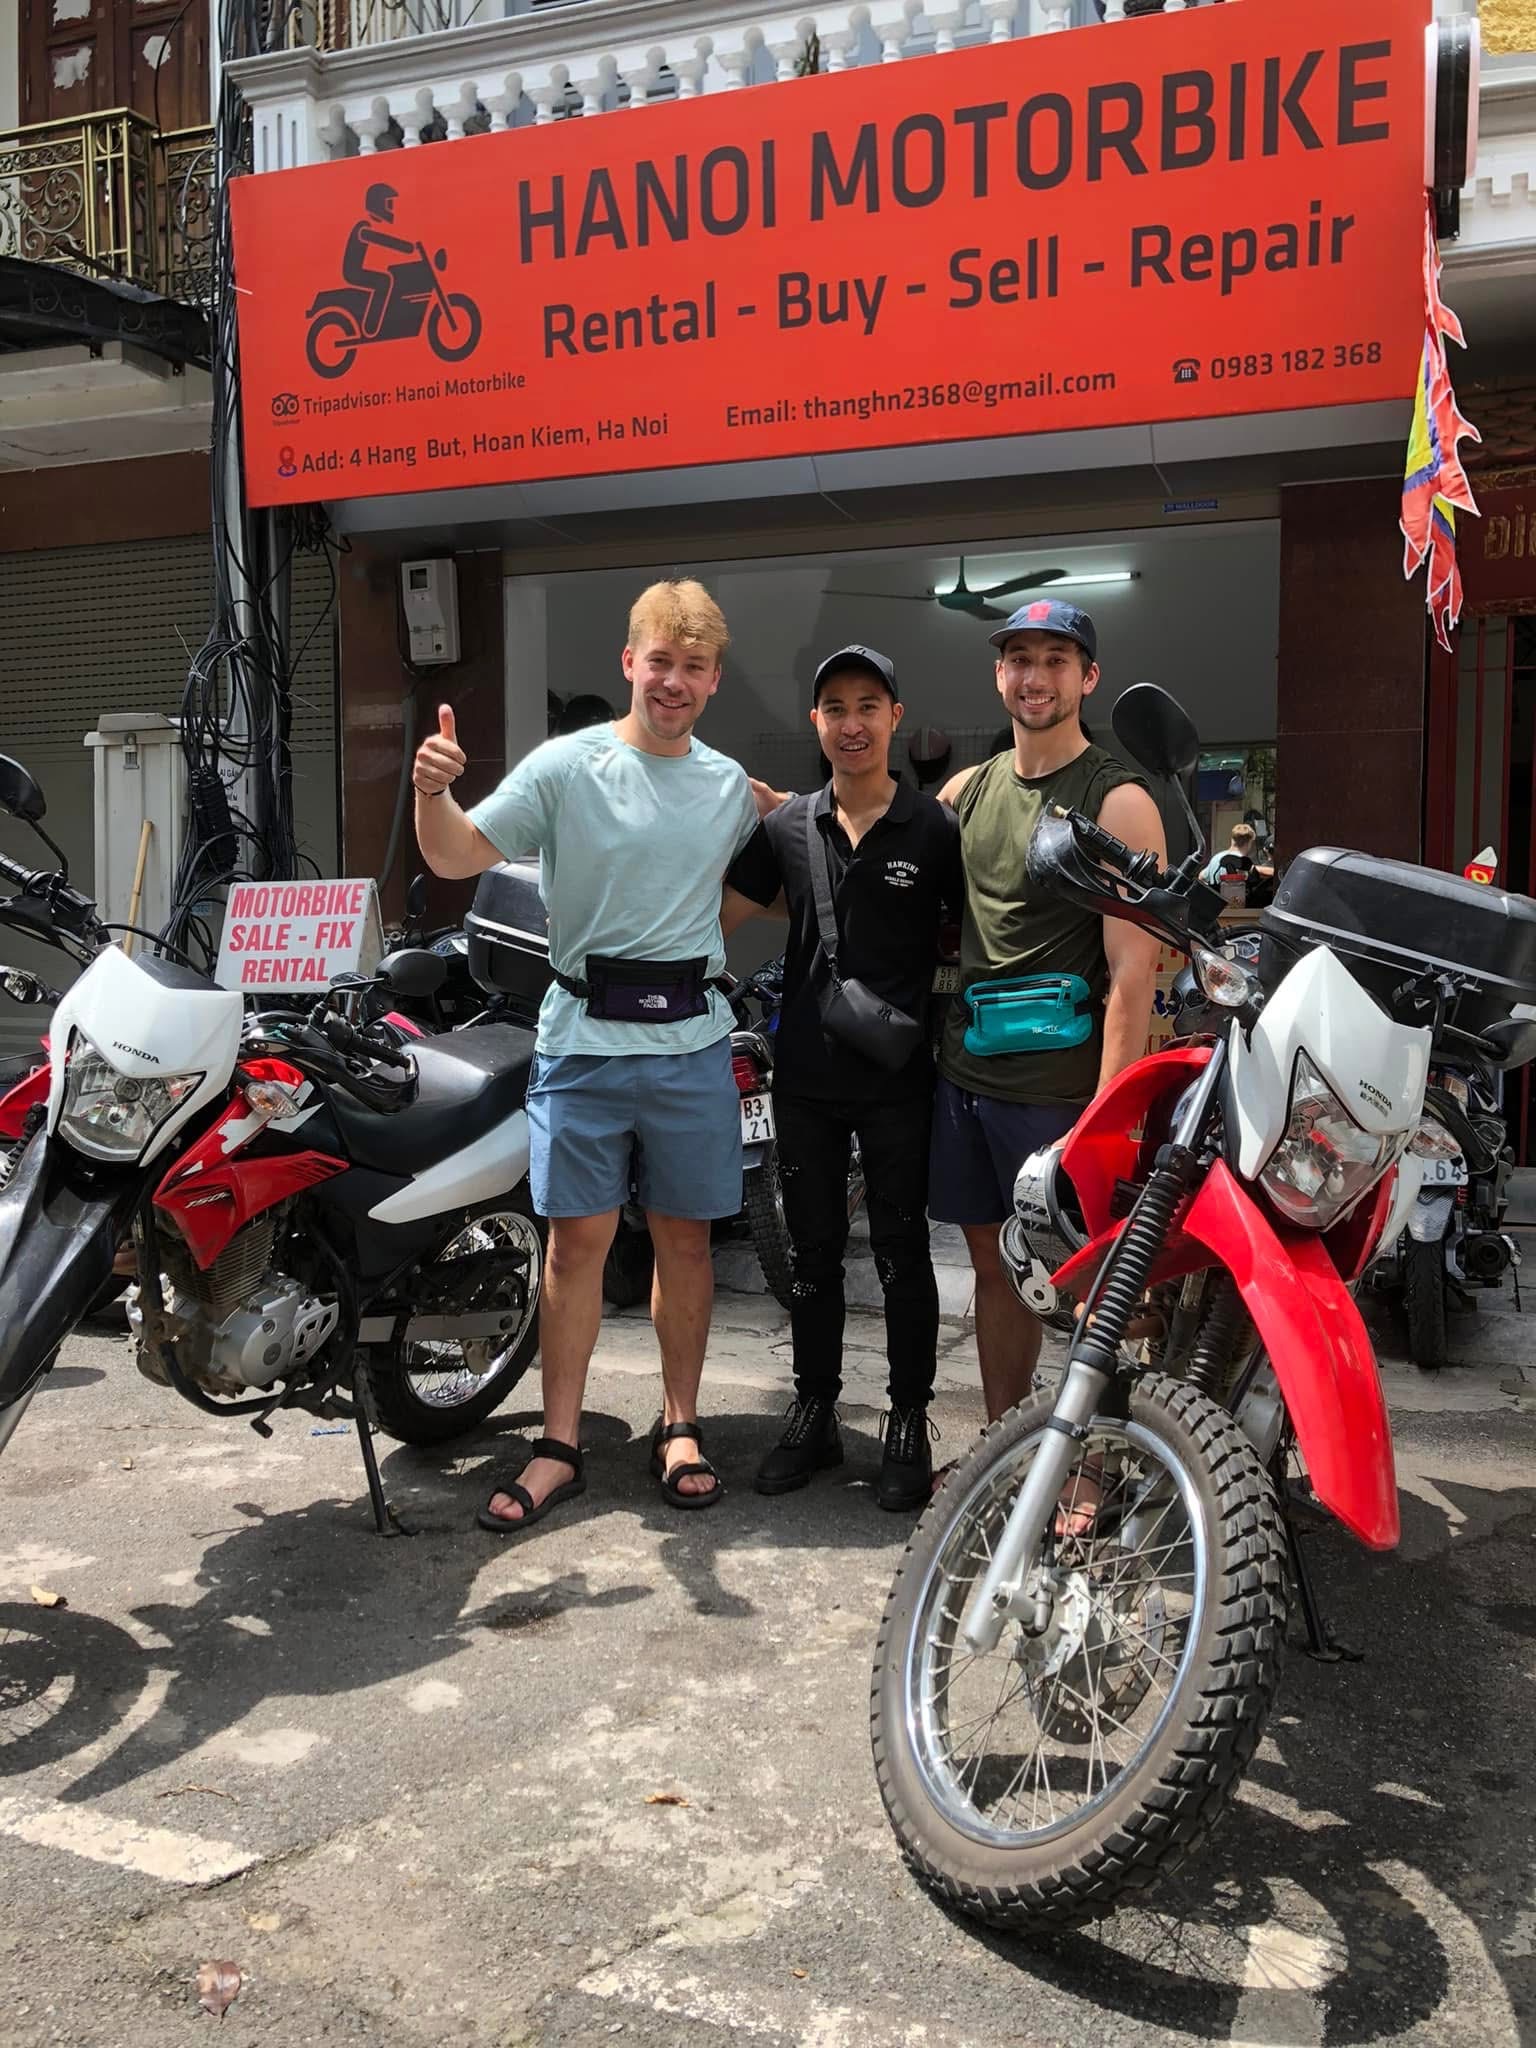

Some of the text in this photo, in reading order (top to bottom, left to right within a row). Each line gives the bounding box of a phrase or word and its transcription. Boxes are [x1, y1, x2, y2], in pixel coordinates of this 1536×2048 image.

[518, 39, 1392, 264] HANOI MOTORBIKE
[543, 199, 1355, 359] Rental - Buy - Sell - Repair
[1211, 341, 1382, 380] 0983 182 368
[304, 372, 525, 416] Tripadvisor: Hanoi Motorbike
[726, 372, 1116, 427] Email: thanghn2368@gmail.com
[302, 412, 668, 473] Add: 4 Hang But, Hoan Kiem, Ha Noi
[886, 860, 920, 874] HAWKINS
[230, 883, 366, 919] MOTORBIKE
[229, 923, 291, 952] SALE
[314, 921, 355, 949] FIX
[241, 957, 329, 984] RENTAL
[112, 1041, 161, 1065] HONDA
[1359, 1079, 1393, 1111] HONDA
